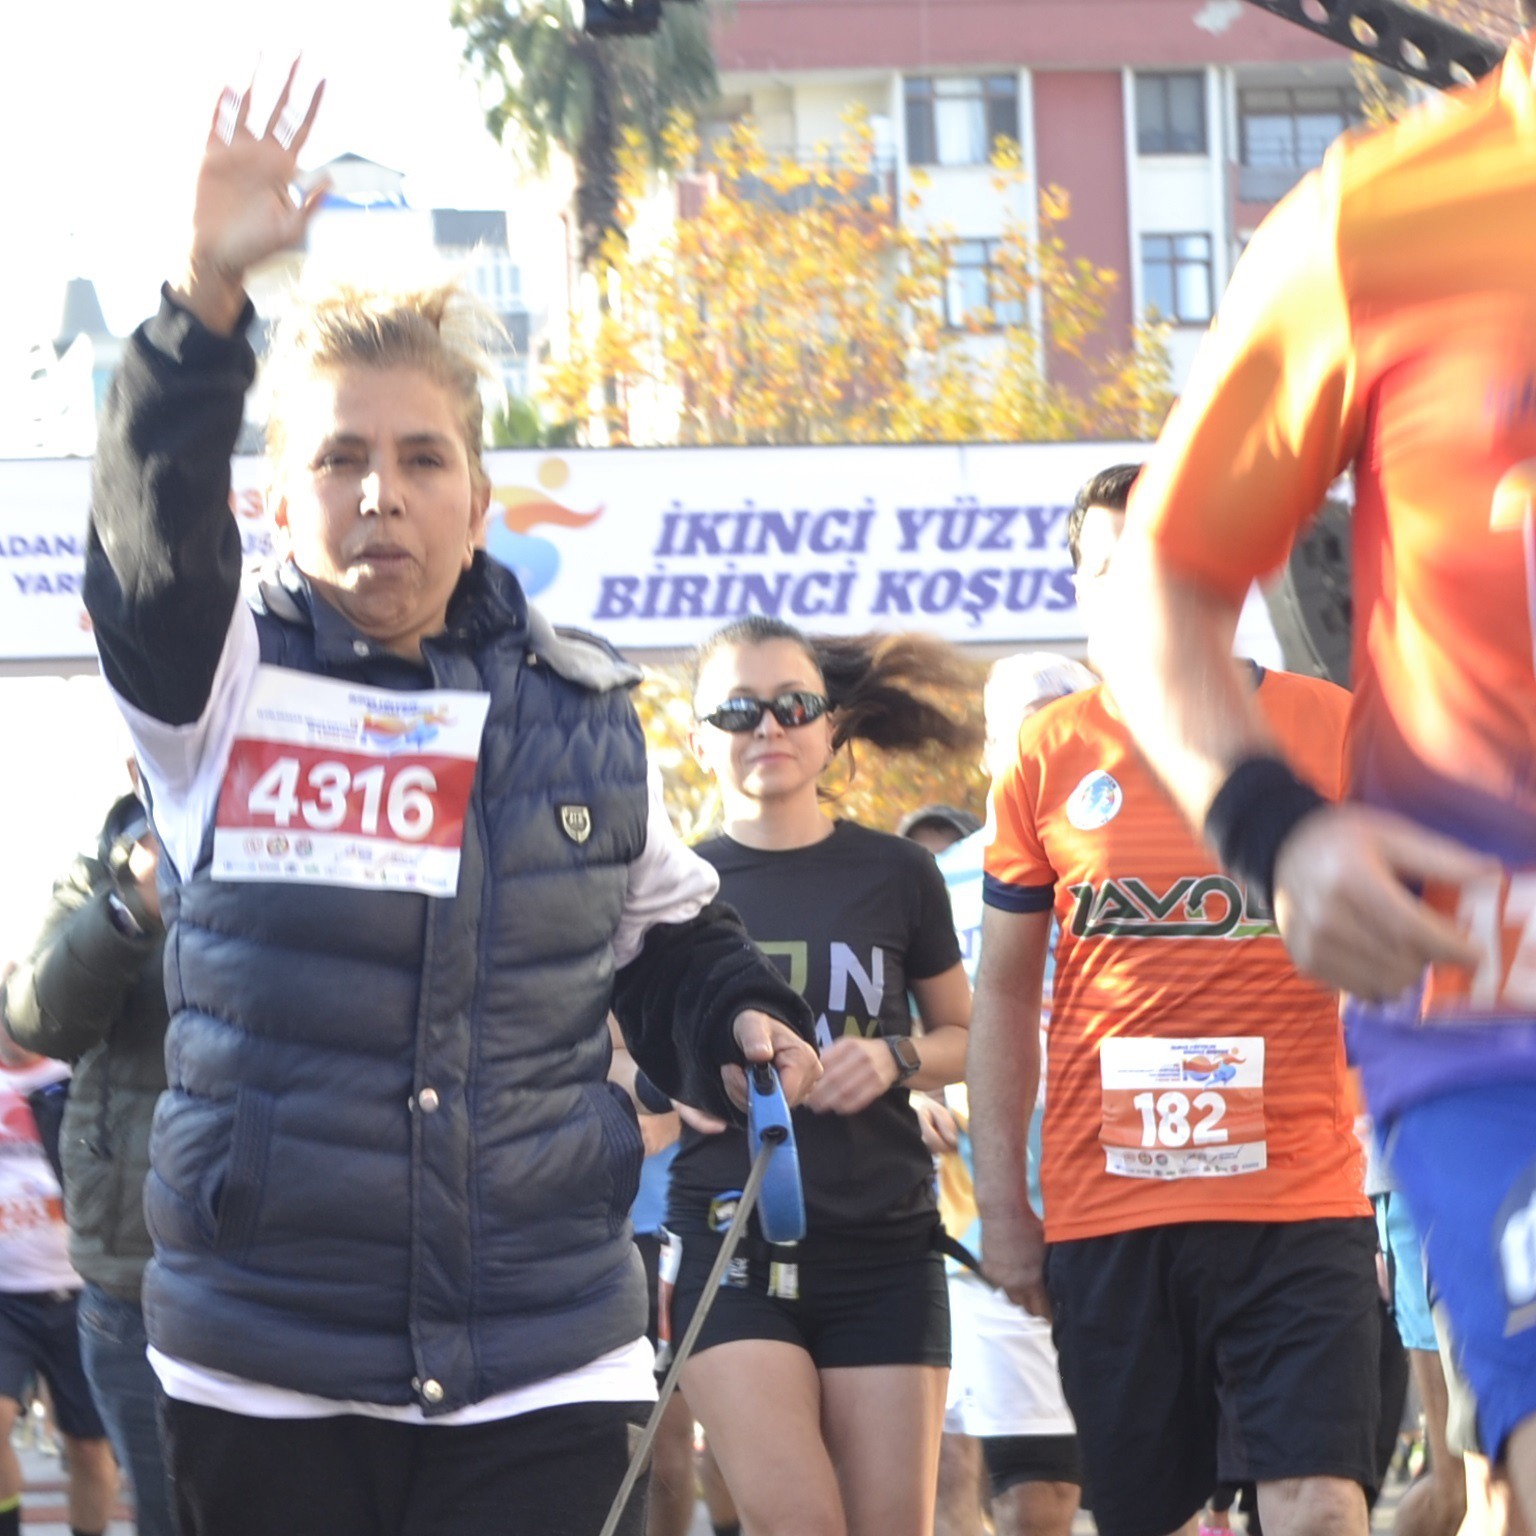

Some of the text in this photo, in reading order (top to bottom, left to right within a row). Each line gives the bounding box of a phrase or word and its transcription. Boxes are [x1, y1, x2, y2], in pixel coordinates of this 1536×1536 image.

[654, 497, 1072, 557] İKİNCİ YÜZY
[592, 560, 858, 620] BİRİNCİ
[248, 757, 438, 842] 4316
[1133, 1091, 1228, 1147] 182
